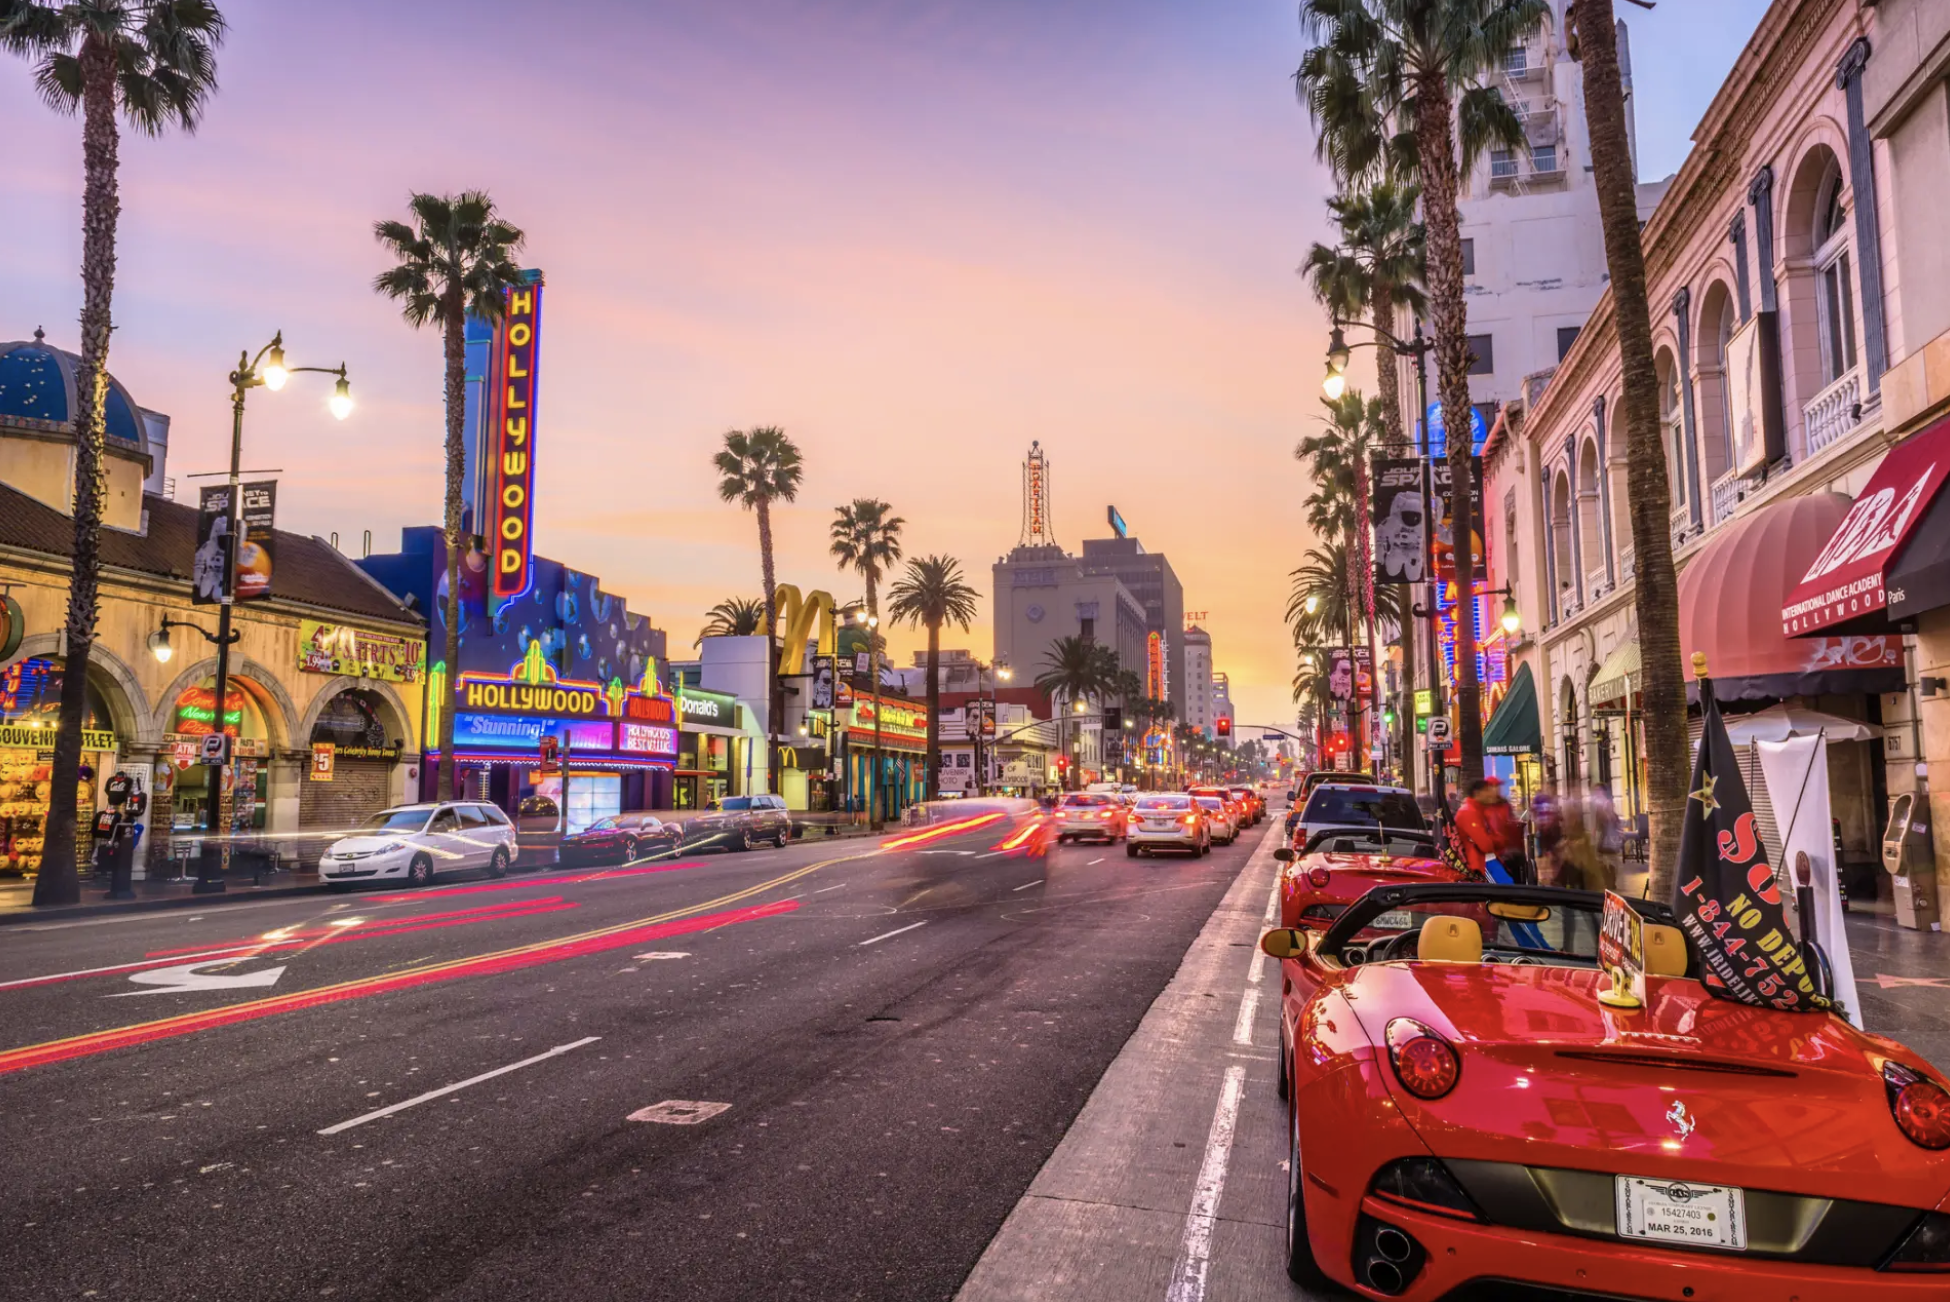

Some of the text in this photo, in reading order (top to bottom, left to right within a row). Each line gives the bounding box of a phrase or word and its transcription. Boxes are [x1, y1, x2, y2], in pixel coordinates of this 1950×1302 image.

[501, 290, 531, 573] HOLLYWOOD
[205, 496, 271, 512] SPCE
[1781, 571, 1882, 620] INTERNATIONAL DANCE ACADEMY
[1888, 588, 1906, 604] Paris
[1783, 589, 1885, 634] HOLLYWOOD
[467, 683, 595, 714] HOLLYWOOD
[182, 705, 211, 720] New
[629, 696, 671, 721] HOLLYWOOD
[0, 728, 113, 748] OUVENI TLET
[177, 743, 195, 755] ATM
[1508, 745, 1531, 753] GALORE
[313, 753, 329, 771] $5
[1007, 765, 1017, 773] OF
[1725, 892, 1762, 929] NO
[1661, 1207, 1701, 1220] 15427403
[1648, 1222, 1713, 1237] MAR 25, 2016
